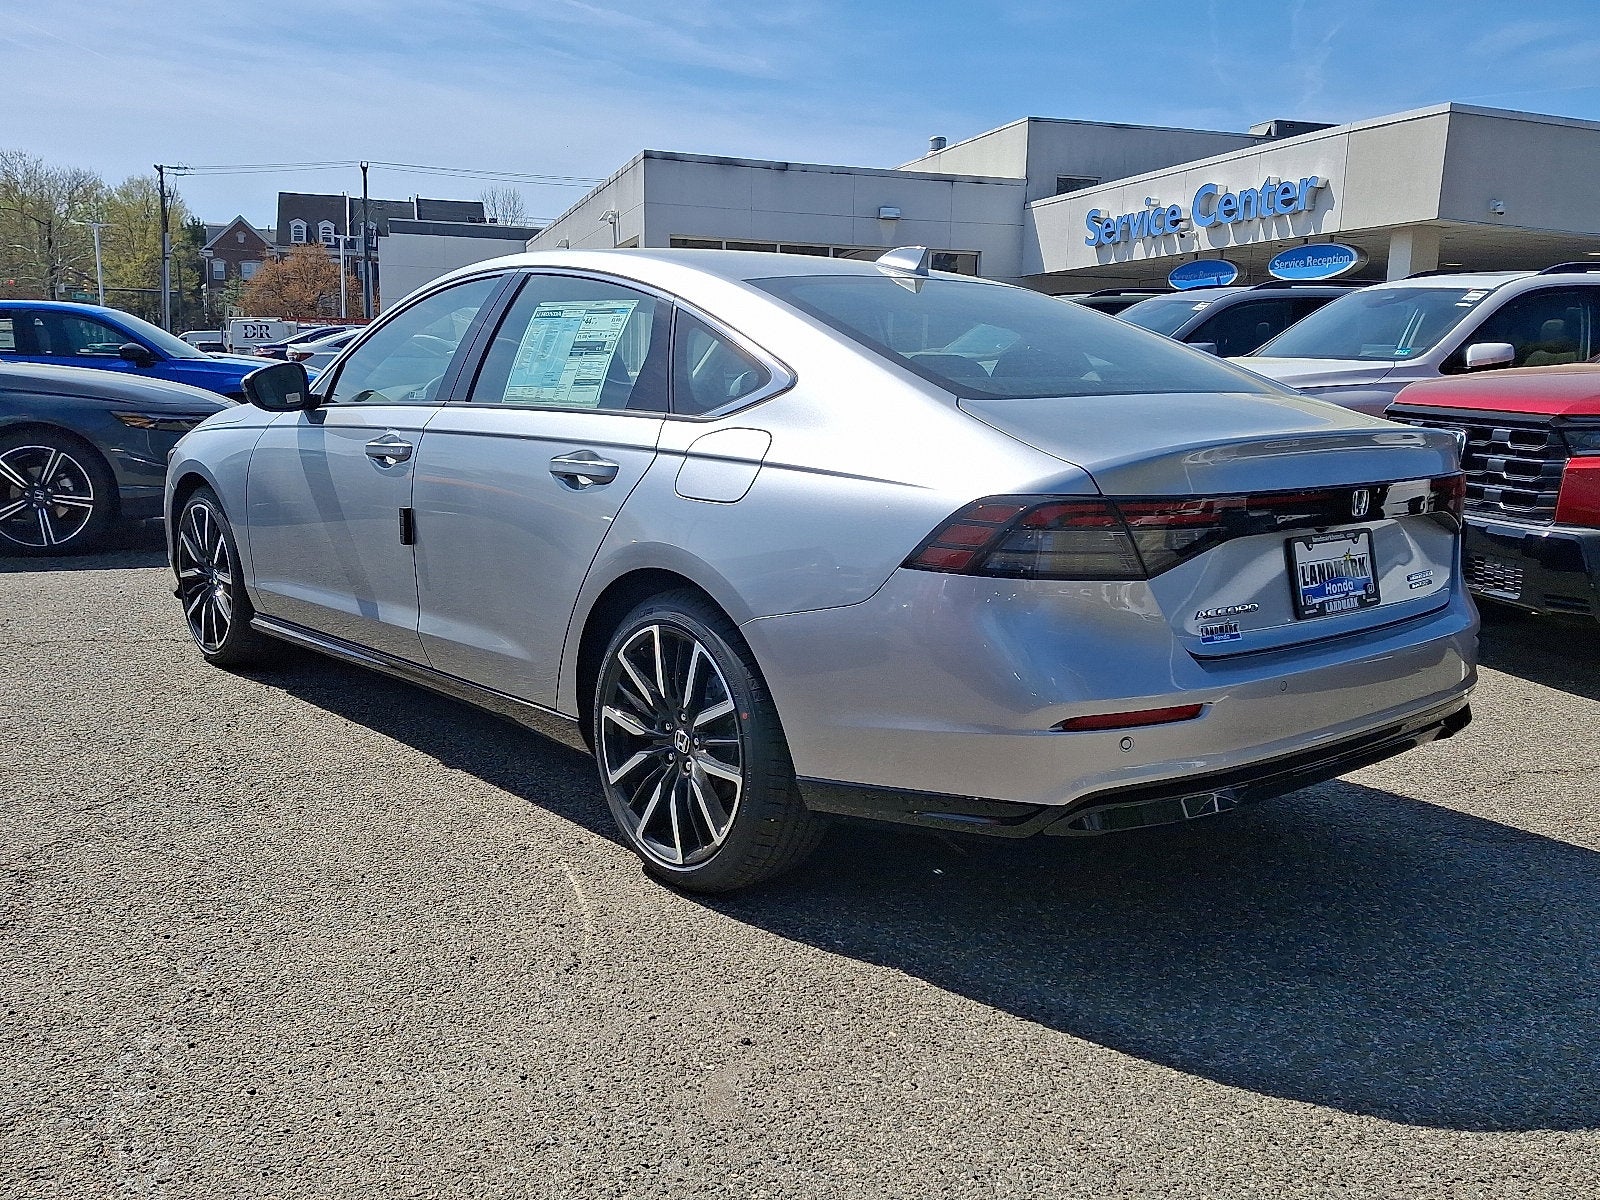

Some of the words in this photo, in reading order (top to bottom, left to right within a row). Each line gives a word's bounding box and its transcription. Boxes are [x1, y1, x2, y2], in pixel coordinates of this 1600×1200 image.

[1085, 197, 1182, 247] Service
[1192, 176, 1319, 228] Center
[1274, 257, 1305, 269] Service
[1306, 253, 1350, 268] Reception
[1300, 556, 1369, 587] LANDMARK
[1325, 580, 1354, 595] Honda
[1194, 603, 1259, 620] ACCORD
[1325, 597, 1358, 612] LANDMARK
[1200, 623, 1239, 637] LANDMARK
